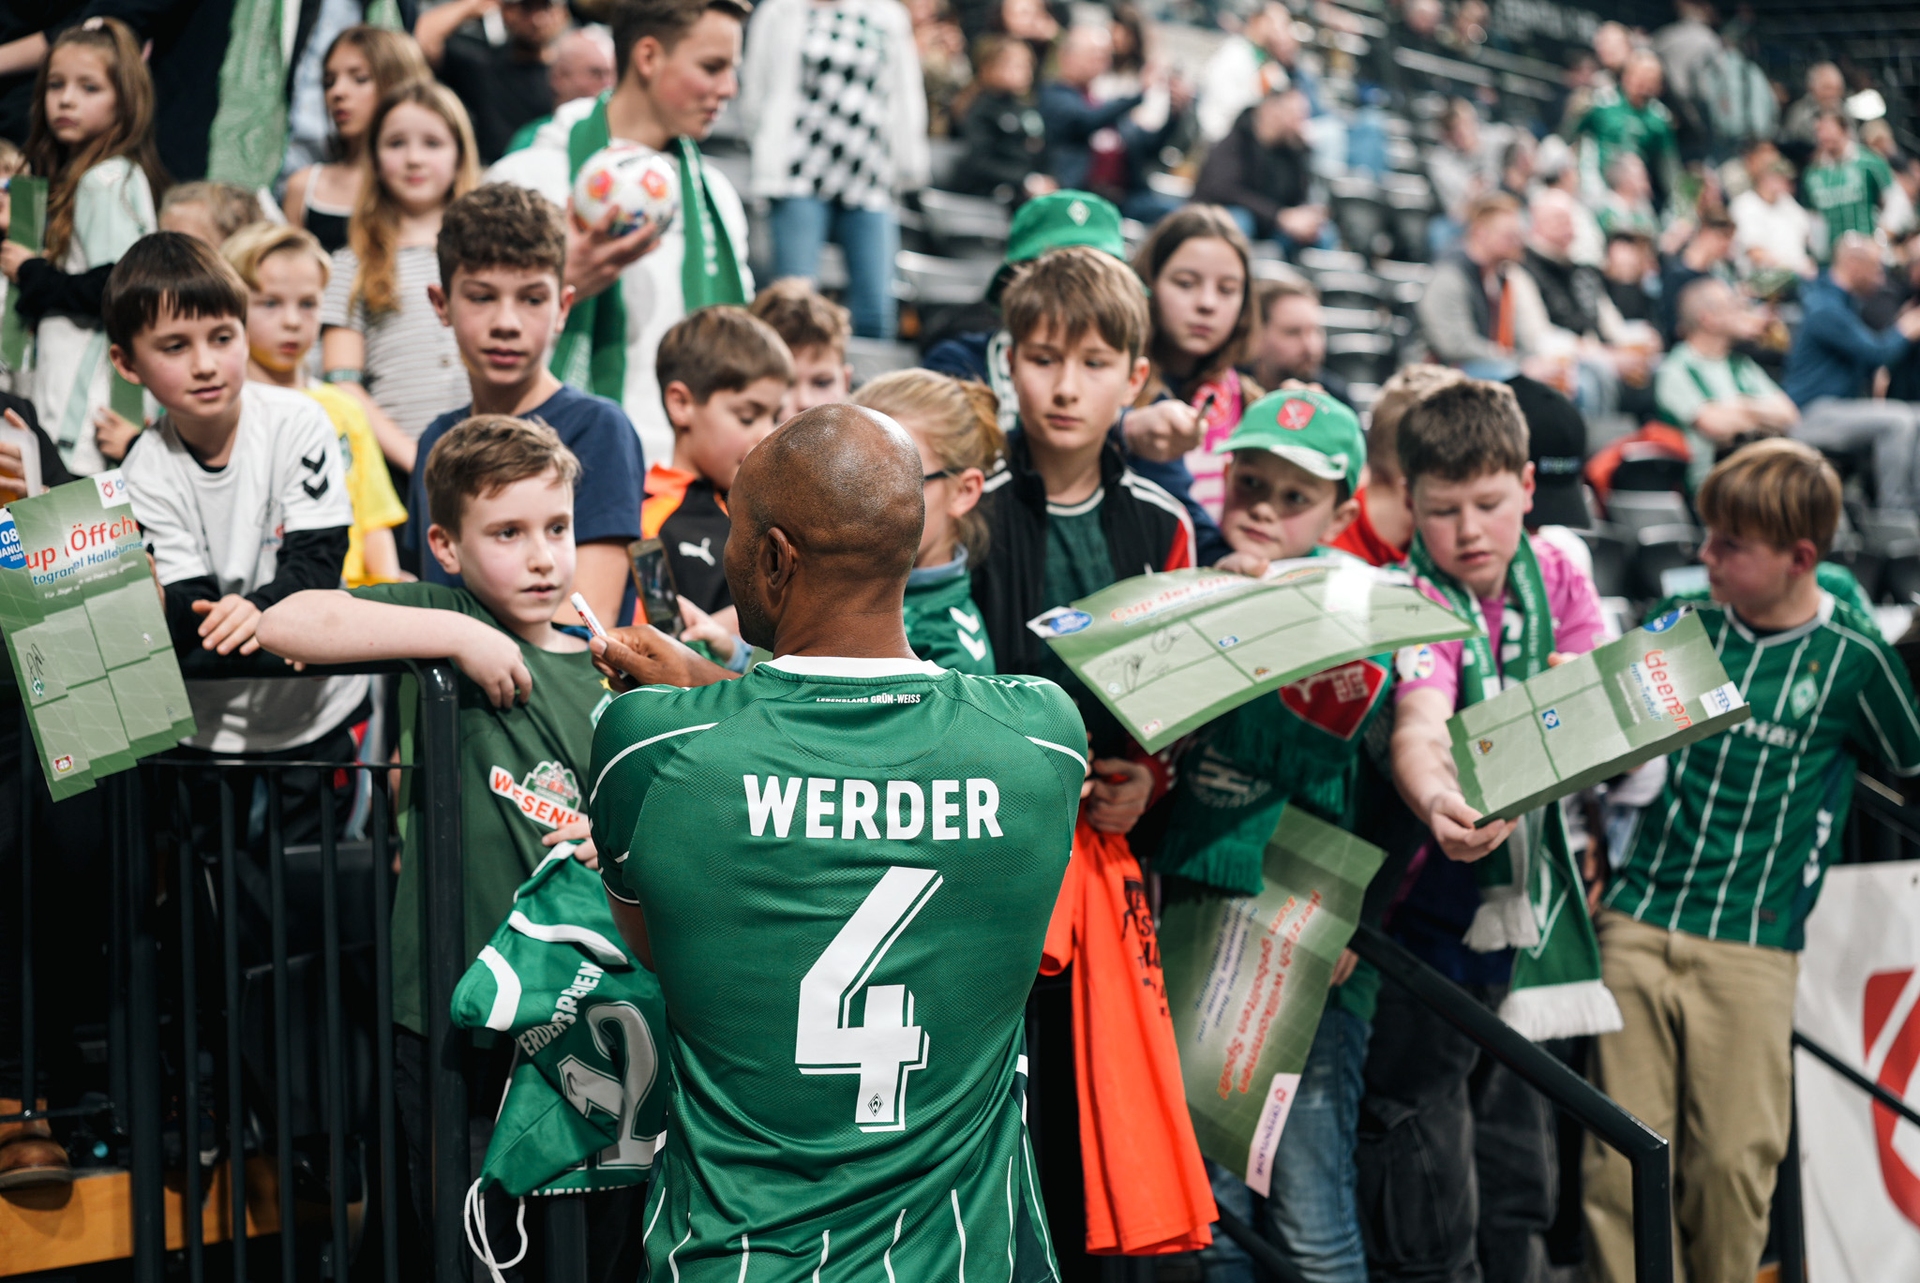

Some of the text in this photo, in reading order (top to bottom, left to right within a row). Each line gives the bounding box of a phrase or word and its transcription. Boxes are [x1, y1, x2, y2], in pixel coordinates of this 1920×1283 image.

[1, 528, 19, 545] 08
[870, 692, 921, 704] GRÜN-WEISS
[743, 774, 1003, 840] WERDER
[795, 866, 943, 1132] 4
